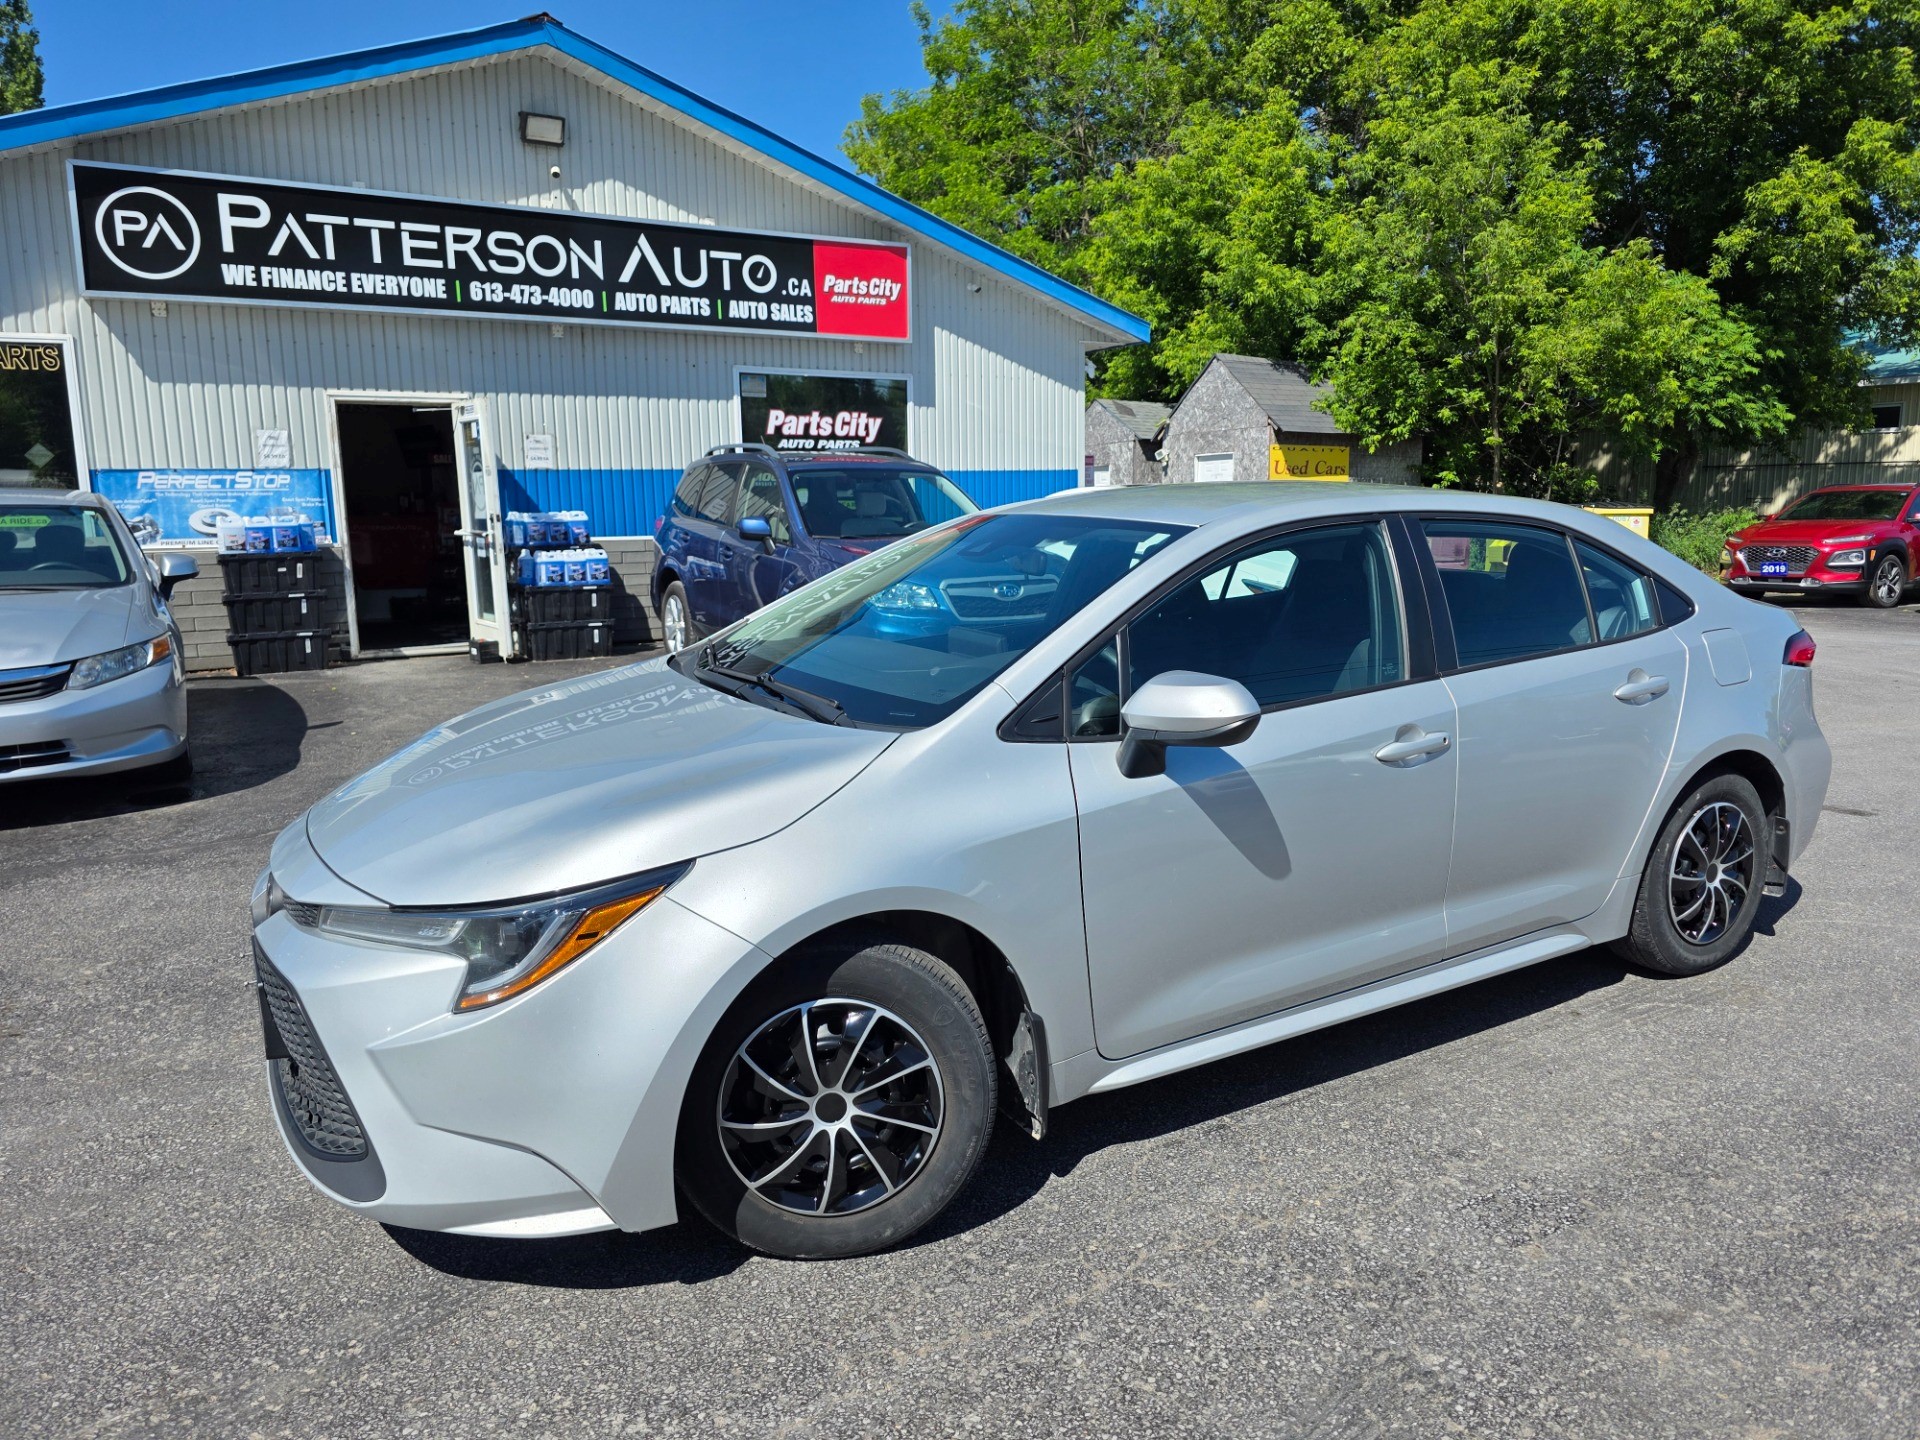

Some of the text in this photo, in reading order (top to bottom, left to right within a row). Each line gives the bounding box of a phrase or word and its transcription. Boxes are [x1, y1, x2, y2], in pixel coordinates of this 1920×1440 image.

[113, 209, 187, 250] PA
[216, 192, 604, 281] PATTERSON
[617, 232, 778, 294] AUTO
[220, 263, 447, 299] WE FINANCE EVERYONE
[469, 280, 595, 309] 613-473-4000
[614, 291, 711, 316] AUTO PARTS
[830, 295, 887, 305] AUTO PARTS
[728, 299, 814, 323] AUTO SALES
[777, 438, 860, 450] AUTO PARTS
[1273, 460, 1347, 476] Used Cars
[1762, 565, 1786, 573] 2019
